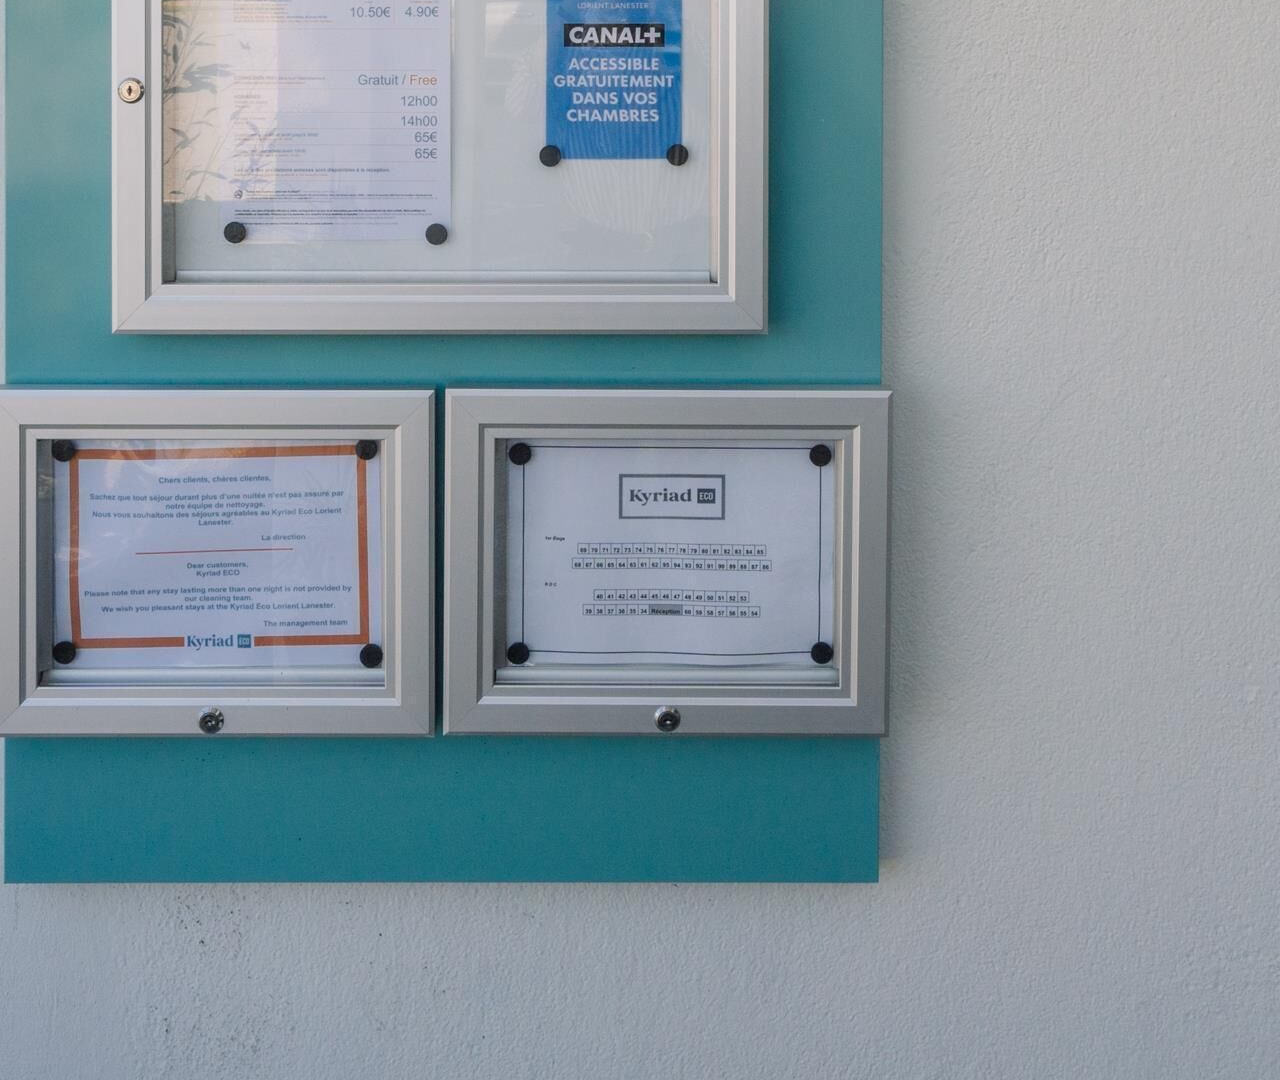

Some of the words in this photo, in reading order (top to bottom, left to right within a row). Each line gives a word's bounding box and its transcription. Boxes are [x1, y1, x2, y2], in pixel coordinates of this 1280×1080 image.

[351, 6, 391, 18] 10.50€
[404, 6, 439, 18] 4.90€
[569, 26, 661, 44] CANAL+
[569, 58, 660, 71] ACCESSIBLE
[357, 74, 398, 86] Gratuit
[409, 74, 438, 85] Free
[553, 75, 675, 88] GRATUITEMENT
[401, 95, 438, 107] 12h00
[573, 92, 618, 105] DANS
[623, 92, 658, 105] VOS
[401, 115, 438, 127] 14h00
[566, 109, 660, 122] CHAMBRES
[414, 132, 438, 143] 65€
[414, 148, 438, 159] 65€
[158, 476, 181, 484] Chers
[89, 493, 115, 501] Sachez
[117, 494, 131, 502] que
[174, 493, 200, 501] durant
[201, 493, 217, 502] plus
[629, 487, 692, 506] Kyriad
[698, 491, 715, 501] ECO
[132, 511, 174, 519] souhaitons
[271, 508, 297, 517] Kyriad
[314, 507, 342, 515] Lorient
[272, 533, 306, 541] direction
[196, 569, 220, 577] Kyriad
[130, 588, 145, 596] that
[162, 588, 178, 596] stay
[180, 587, 205, 595] lasting
[228, 585, 245, 593] than
[263, 585, 283, 594] night
[307, 584, 341, 593] provided
[342, 584, 352, 593] by
[199, 595, 231, 603] cleaning
[151, 604, 183, 613] pleasant
[185, 604, 205, 612] stays
[230, 603, 254, 611] Kyriad
[256, 602, 271, 610] Eco
[279, 619, 328, 628] management
[186, 634, 233, 651] Kyriad
